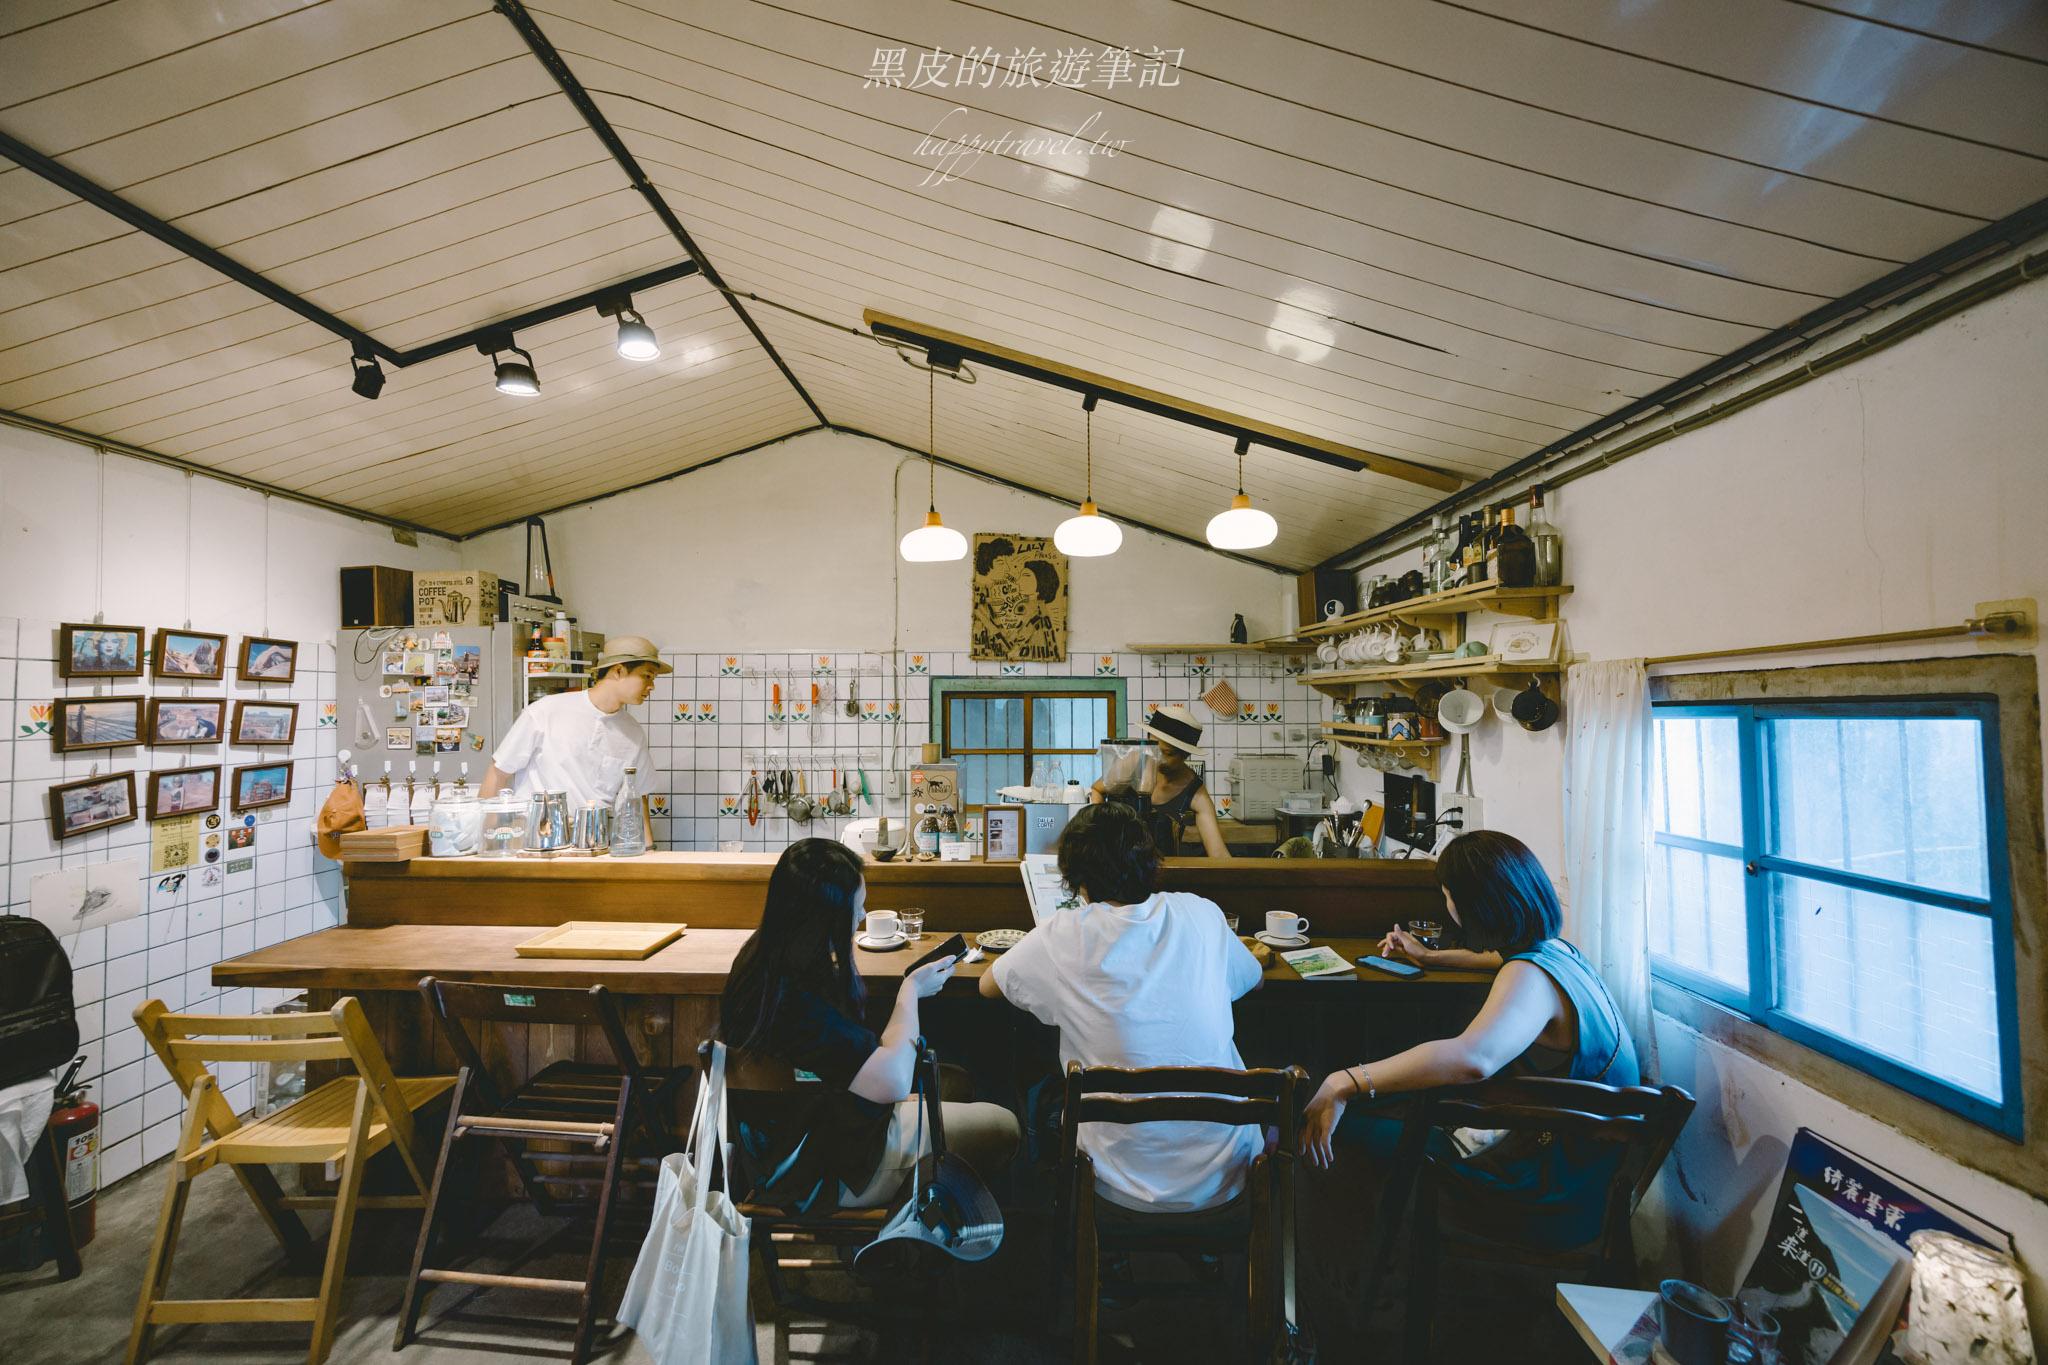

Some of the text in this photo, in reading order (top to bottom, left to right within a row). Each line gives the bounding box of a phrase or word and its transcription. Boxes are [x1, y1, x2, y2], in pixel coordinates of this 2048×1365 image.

[1017, 542, 1046, 555] LAZY
[418, 586, 447, 597] COFFEE
[418, 597, 436, 606] POT
